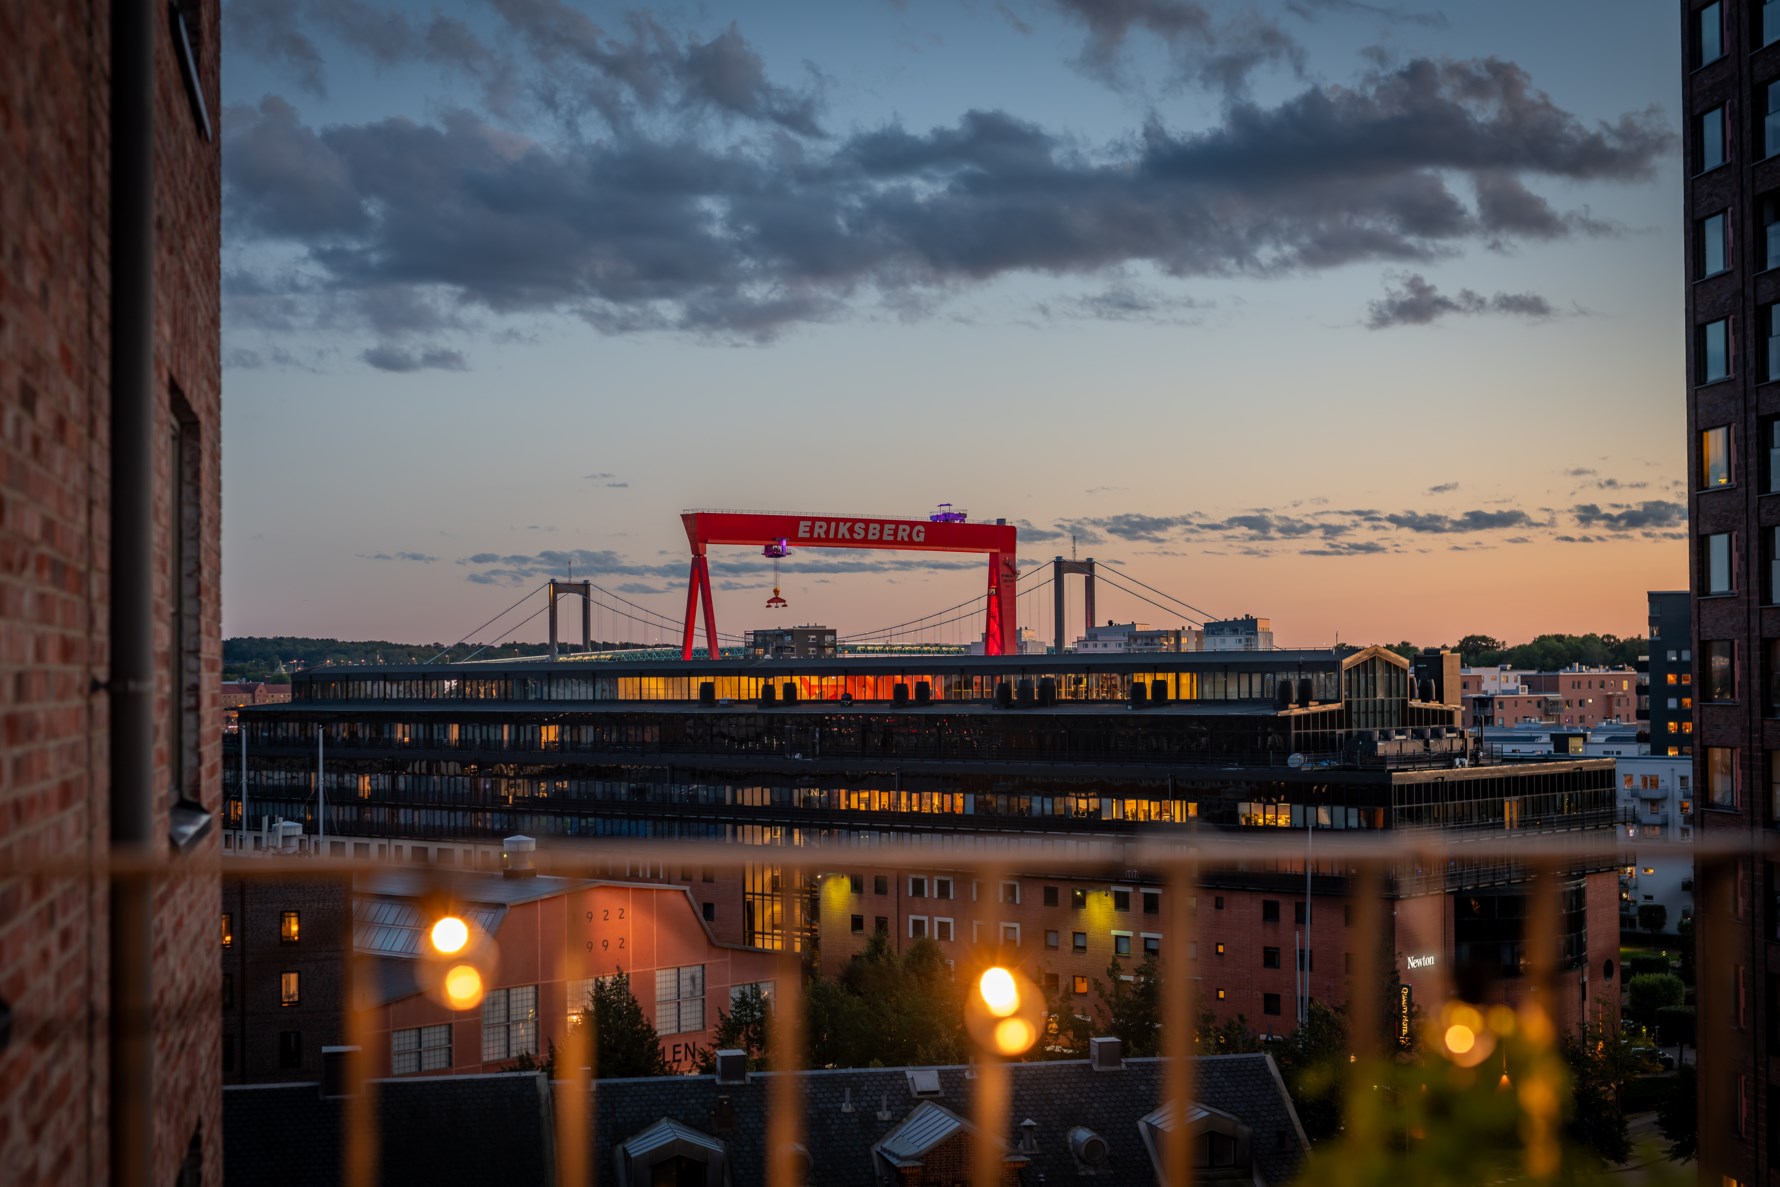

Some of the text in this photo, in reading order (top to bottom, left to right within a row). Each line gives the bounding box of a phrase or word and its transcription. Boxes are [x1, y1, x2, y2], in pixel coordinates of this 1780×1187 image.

[798, 520, 925, 543] ERIKSBERG
[574, 908, 625, 925] 922
[574, 937, 625, 954] 992
[1407, 955, 1435, 970] Newton
[662, 1041, 696, 1063] LEN
